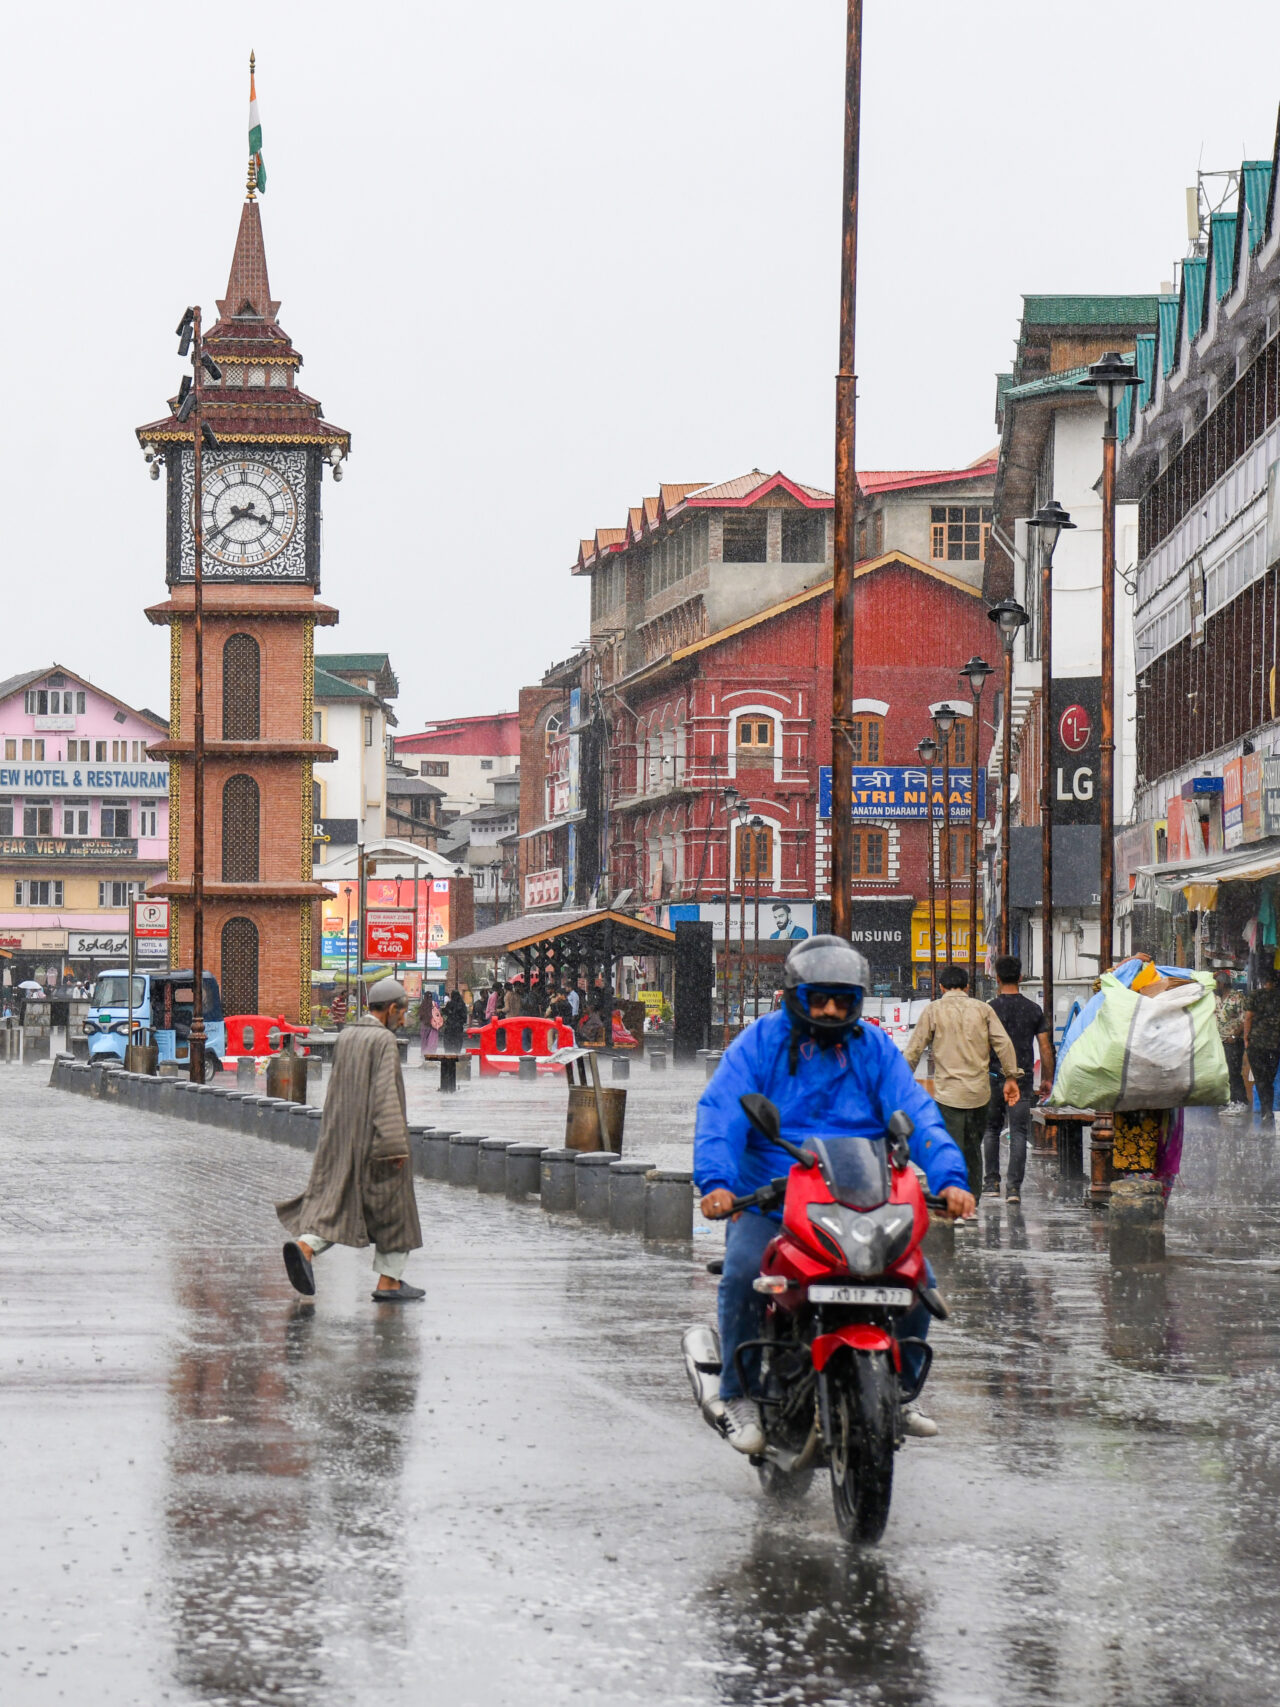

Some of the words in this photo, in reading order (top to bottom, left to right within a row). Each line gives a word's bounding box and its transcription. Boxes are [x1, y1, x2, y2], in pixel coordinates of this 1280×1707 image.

[24, 769, 67, 787] HOTEL
[73, 770, 83, 787] &
[87, 771, 170, 788] RESTAURAN
[1056, 767, 1093, 801] LG
[884, 807, 918, 817] DHARAM
[36, 841, 67, 855] VIEW
[149, 908, 156, 920] P
[851, 930, 902, 942] MSUNG
[919, 928, 983, 946] realm
